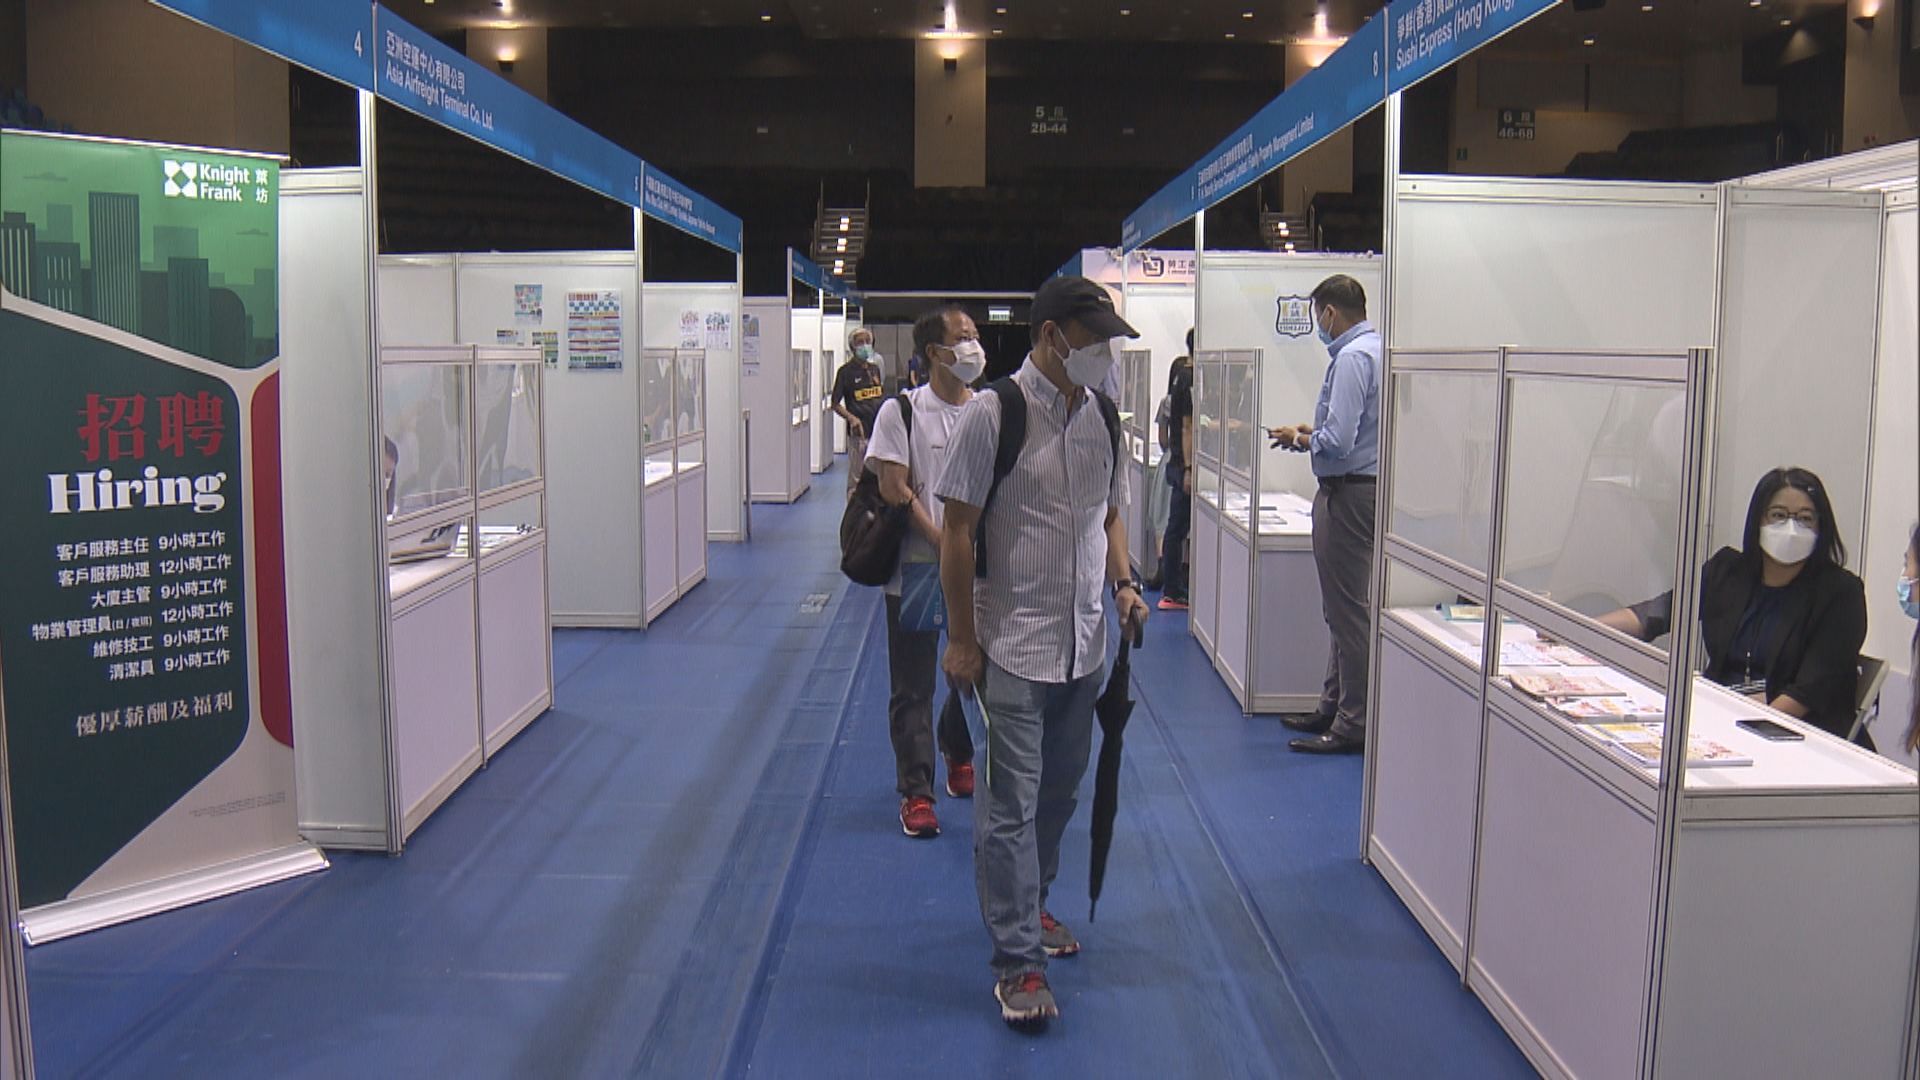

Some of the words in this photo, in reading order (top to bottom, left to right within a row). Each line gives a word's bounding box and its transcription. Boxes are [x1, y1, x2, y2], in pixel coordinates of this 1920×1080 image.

[354, 30, 362, 57] 4
[1396, 41, 1418, 71] Sushi
[1419, 22, 1452, 57] Express
[1454, 3, 1482, 41] (Hong
[1372, 51, 1379, 77] 8
[386, 60, 403, 87] Asia
[405, 70, 439, 105] Airfreight
[440, 88, 469, 118] Terminal
[1036, 105, 1045, 119] 5
[1503, 110, 1513, 123] 6
[200, 163, 250, 186] Knight
[200, 182, 242, 202] Frank
[77, 390, 225, 463] 招聘
[48, 465, 227, 514] Hiring
[158, 530, 226, 551] 9小時工作
[160, 553, 232, 575] 12小時工作
[161, 578, 228, 600] 9小時工作
[162, 601, 234, 624] 12小時工作
[93, 635, 154, 659] 維修技工
[163, 625, 230, 648] 9小時工作
[109, 659, 155, 681] 清潔員
[164, 648, 231, 672] 9小時工作
[75, 690, 233, 737] 優厚薪酬及福利
